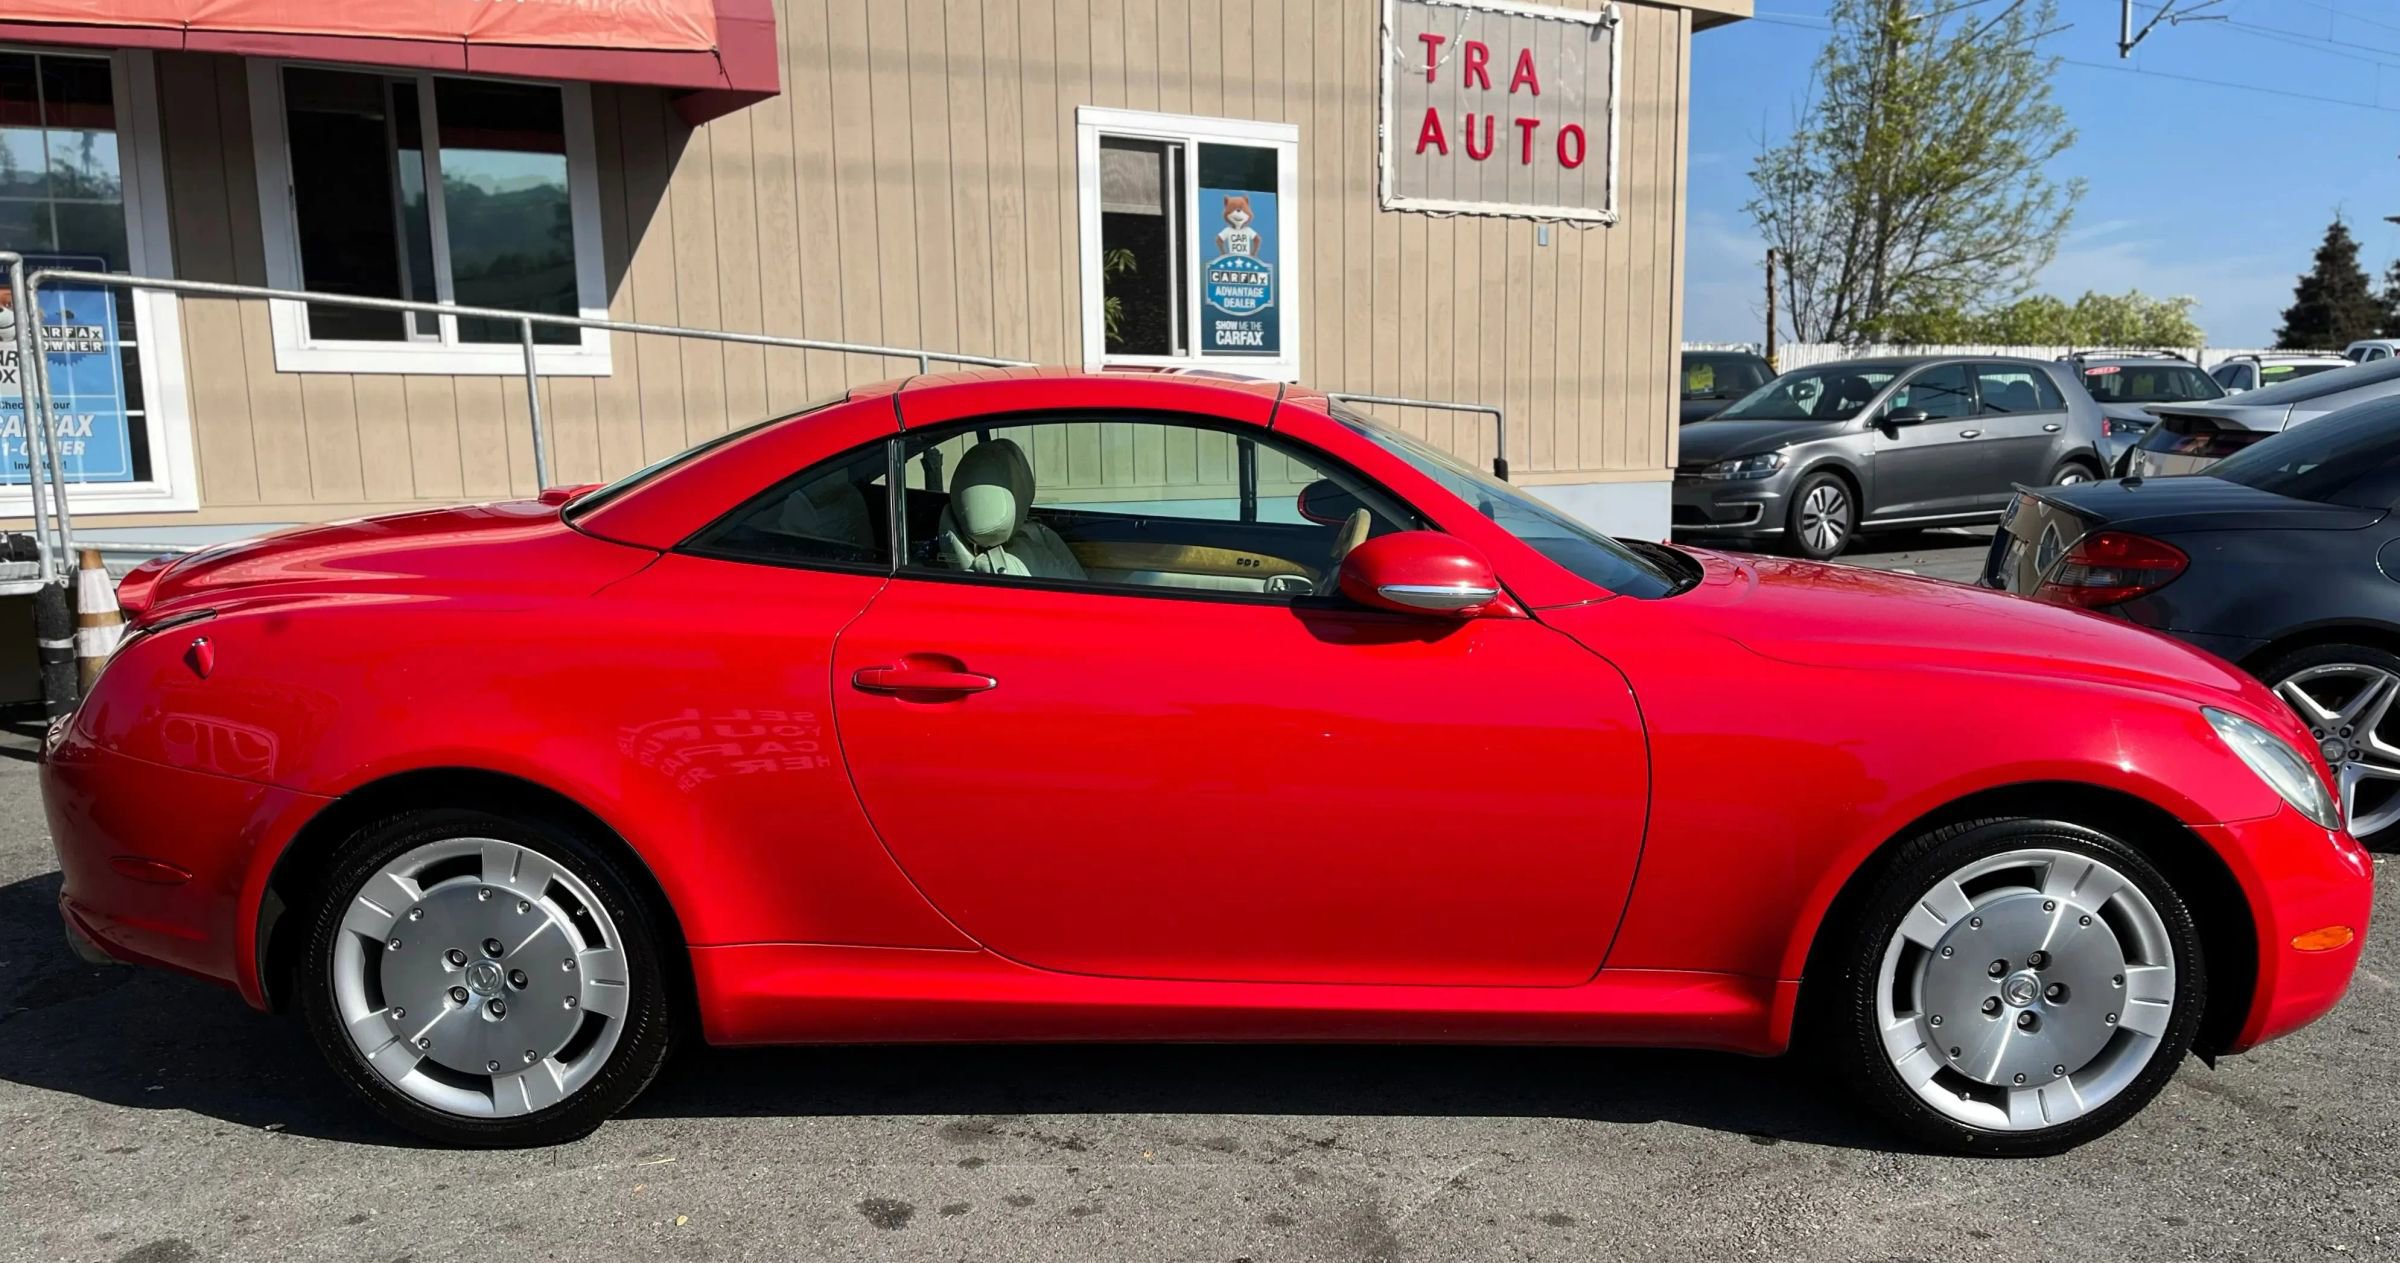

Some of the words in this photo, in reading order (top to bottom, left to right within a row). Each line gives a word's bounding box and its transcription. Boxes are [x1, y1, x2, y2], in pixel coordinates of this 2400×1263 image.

[1418, 33, 1541, 96] TRA
[1415, 107, 1586, 169] AUTO
[1231, 244, 1248, 253] FOX
[1212, 271, 1268, 285] CARFAX
[1215, 286, 1265, 298] ADVANTAGE
[1223, 298, 1256, 308] DEALER
[1216, 320, 1238, 330] SHOW
[1239, 321, 1249, 330] ME
[1250, 321, 1263, 331] THE
[28, 326, 103, 340] ARFAX
[1215, 330, 1265, 346] CARFAX
